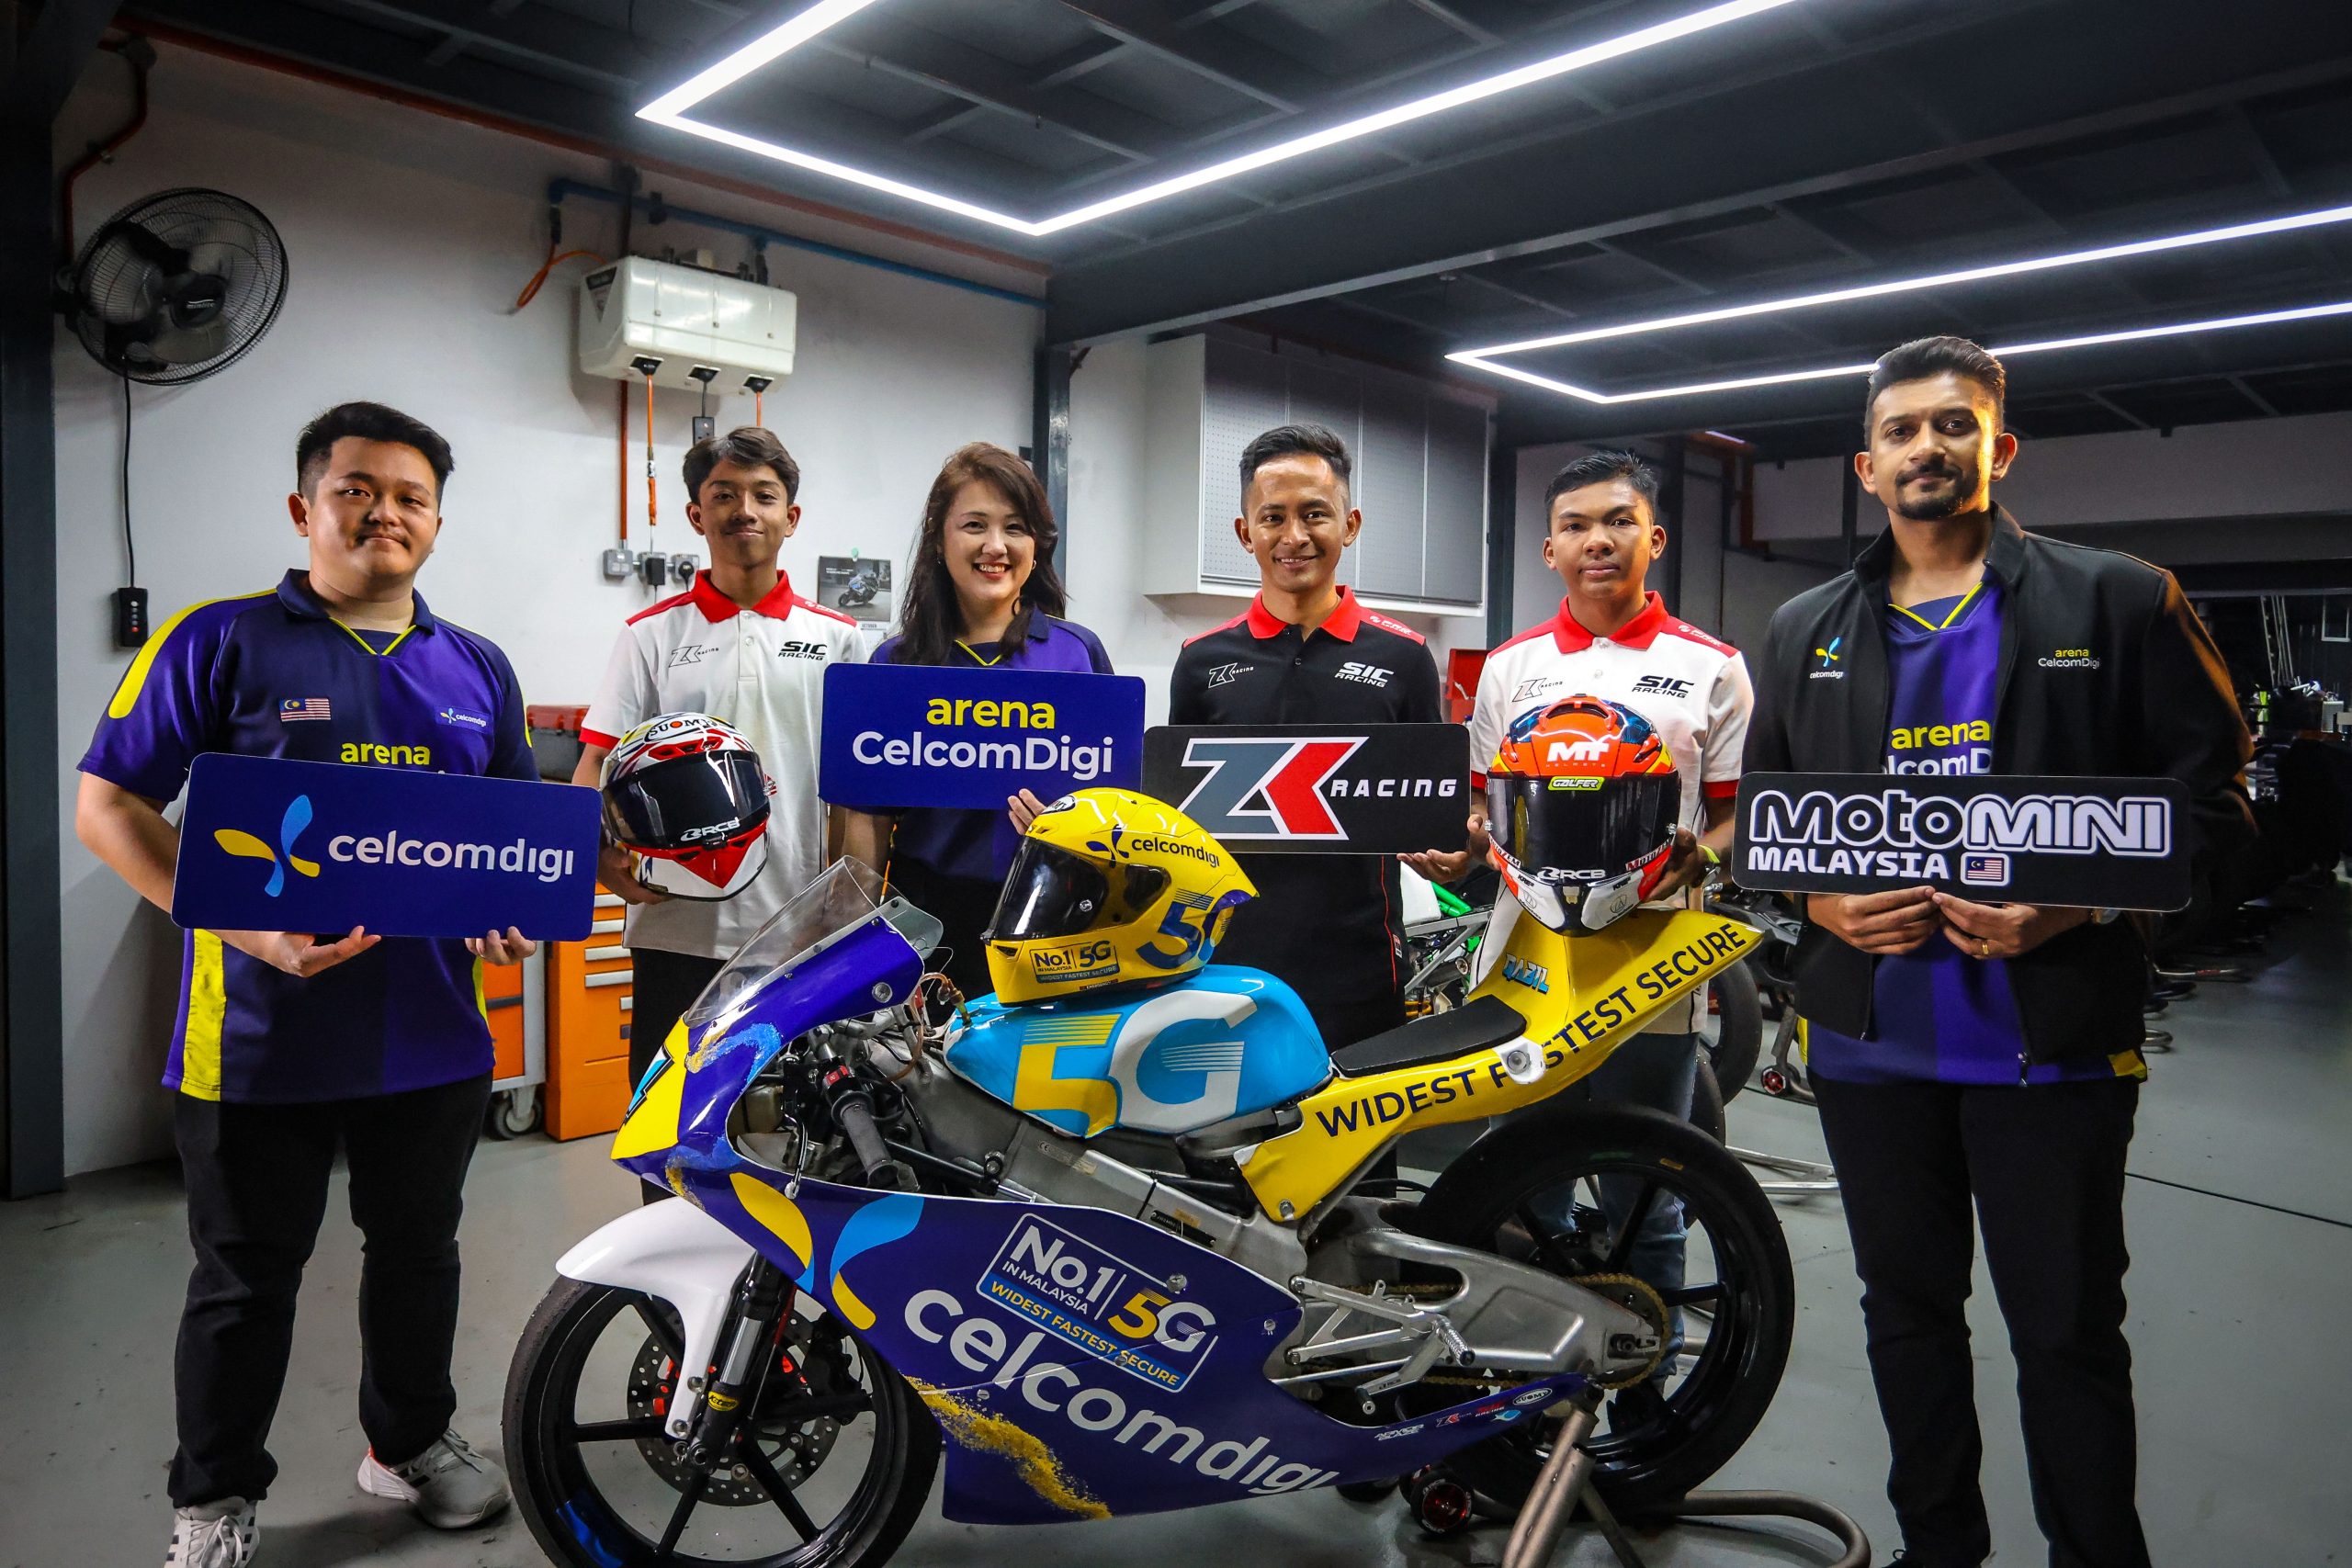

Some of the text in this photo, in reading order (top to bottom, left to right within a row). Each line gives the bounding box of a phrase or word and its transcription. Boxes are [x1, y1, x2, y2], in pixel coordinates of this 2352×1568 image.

[778, 651, 825, 661] RACING
[781, 640, 828, 655] SIC
[2054, 649, 2090, 658] arena
[1340, 661, 1396, 682] SIC
[2038, 657, 2101, 670] CelcomDigi
[1335, 672, 1387, 688] RACING
[1636, 675, 1695, 694] SIC
[1631, 686, 1689, 699] RACING
[926, 698, 1056, 730] arena
[1891, 719, 1991, 750] arena
[340, 742, 431, 766] arena
[852, 731, 1114, 781] CelcomDigi
[1546, 741, 1610, 762] MT
[1329, 778, 1458, 797] RACING
[1747, 846, 1951, 880] MALAYSIA
[1034, 940, 1112, 968] No.1 5G
[1064, 971, 1091, 979] FASTEST
[1091, 965, 1117, 976] SECURE
[1315, 922, 1747, 1138] WIDEST FSTEST SECURE
[1012, 989, 1258, 1138] 5G
[1001, 1260, 1090, 1315] IN MALAYSIA
[1009, 1224, 1217, 1353] No.1 5G
[990, 1280, 1182, 1386] WIDEST FASTEST SECURE
